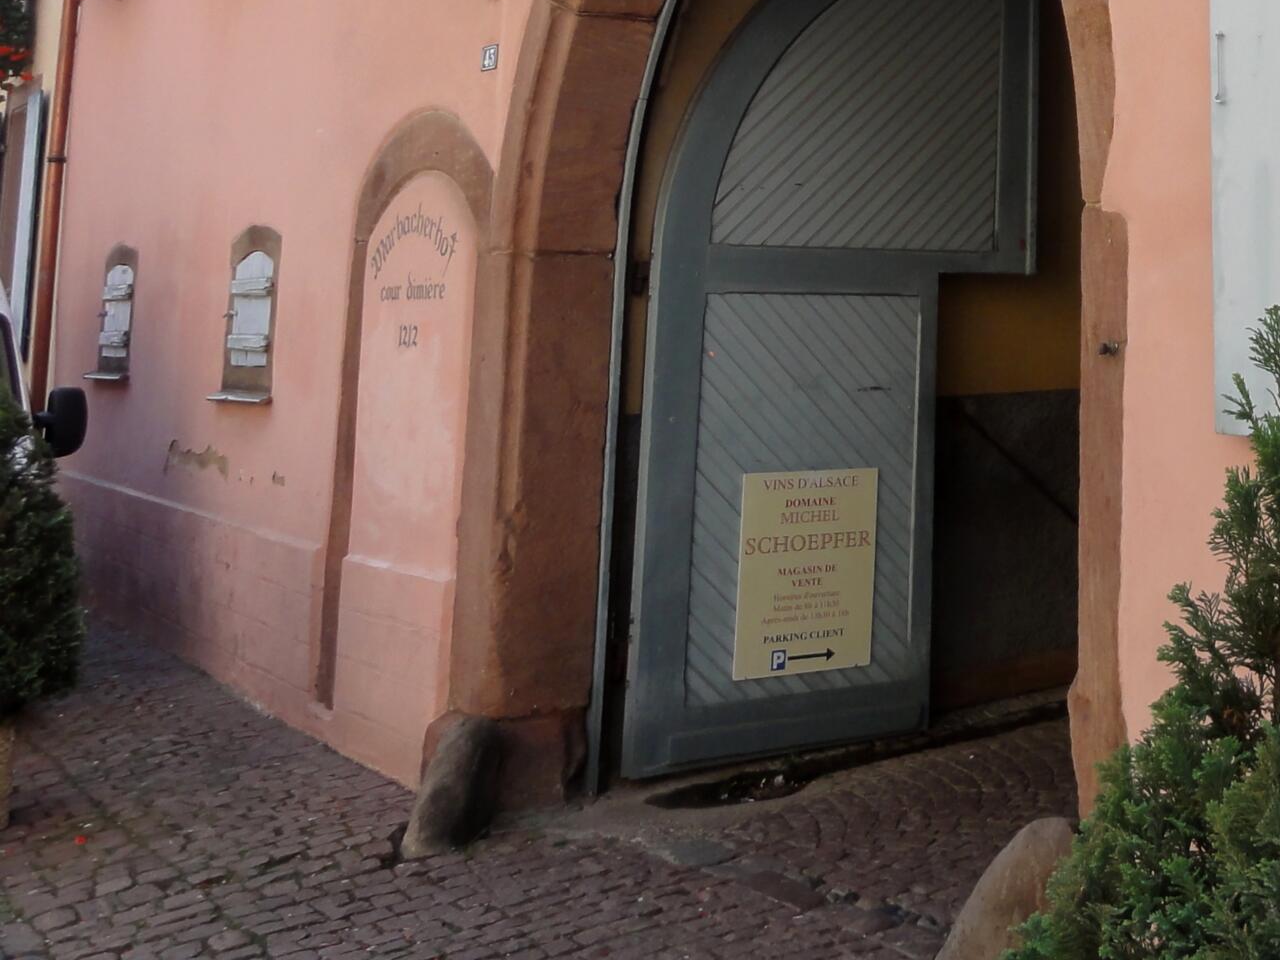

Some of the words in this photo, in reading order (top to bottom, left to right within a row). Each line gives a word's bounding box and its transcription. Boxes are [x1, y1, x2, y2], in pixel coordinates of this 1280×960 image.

[380, 285, 401, 302] cour
[763, 478, 794, 491] VINS
[798, 475, 860, 489] D'ALSACE
[785, 497, 836, 508] DOMAINE
[780, 509, 840, 525] MICHEL
[744, 530, 872, 556] SCHOEPFER
[777, 565, 822, 576] MAGASIN
[825, 564, 836, 573] DE
[791, 578, 823, 587] VENTE
[763, 632, 808, 644] PARKING
[809, 628, 844, 639] CLIENT
[772, 650, 785, 670] P
